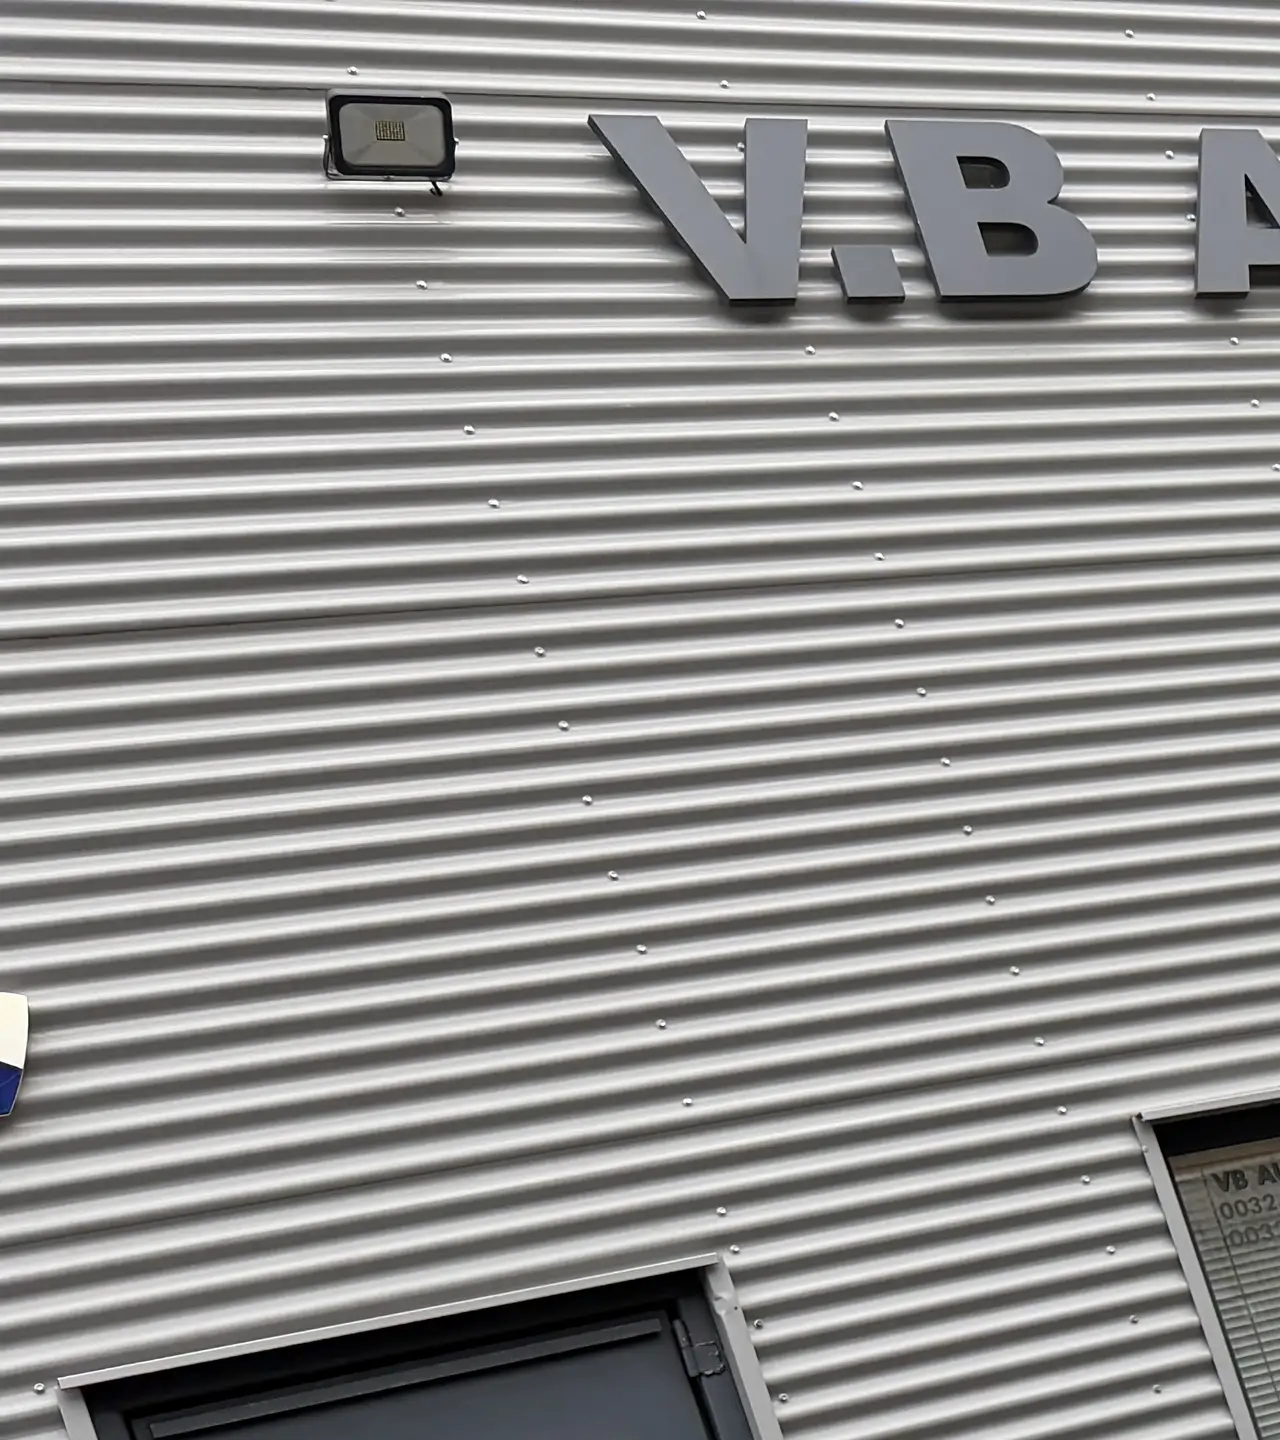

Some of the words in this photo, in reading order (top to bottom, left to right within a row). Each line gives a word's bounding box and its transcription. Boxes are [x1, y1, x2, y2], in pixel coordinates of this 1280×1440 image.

[588, 113, 1098, 306] V.B
[1211, 1169, 1248, 1192] VB
[1220, 1193, 1278, 1219] 0032
